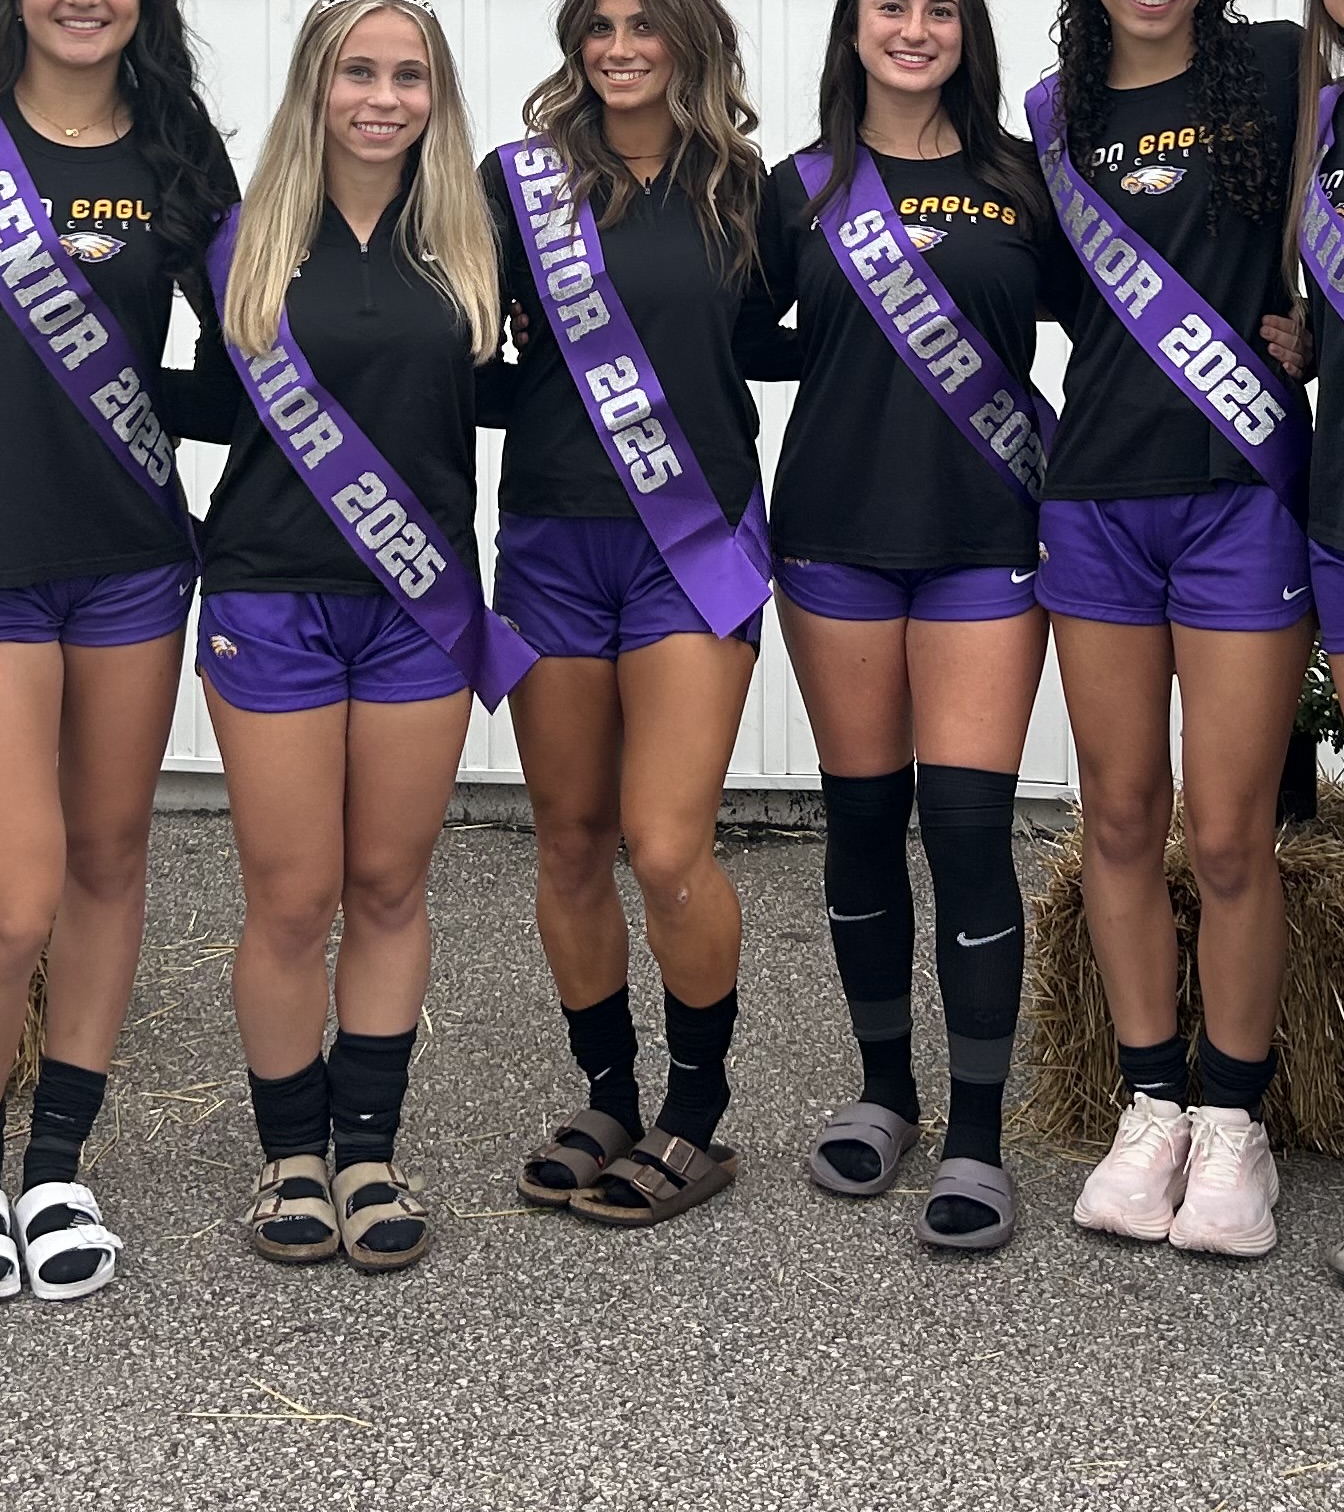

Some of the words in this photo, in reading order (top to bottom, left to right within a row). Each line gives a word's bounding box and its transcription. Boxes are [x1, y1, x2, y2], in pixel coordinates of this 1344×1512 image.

[71, 198, 153, 221] EAGL
[899, 194, 1019, 227] EAGLES
[513, 146, 612, 343] SENIOR
[585, 354, 684, 495] 2025
[838, 208, 983, 395] SENIOR
[89, 366, 174, 487] 2025
[1159, 313, 1287, 446] 2025
[240, 345, 345, 471] NIOR
[331, 471, 448, 601] 2025
